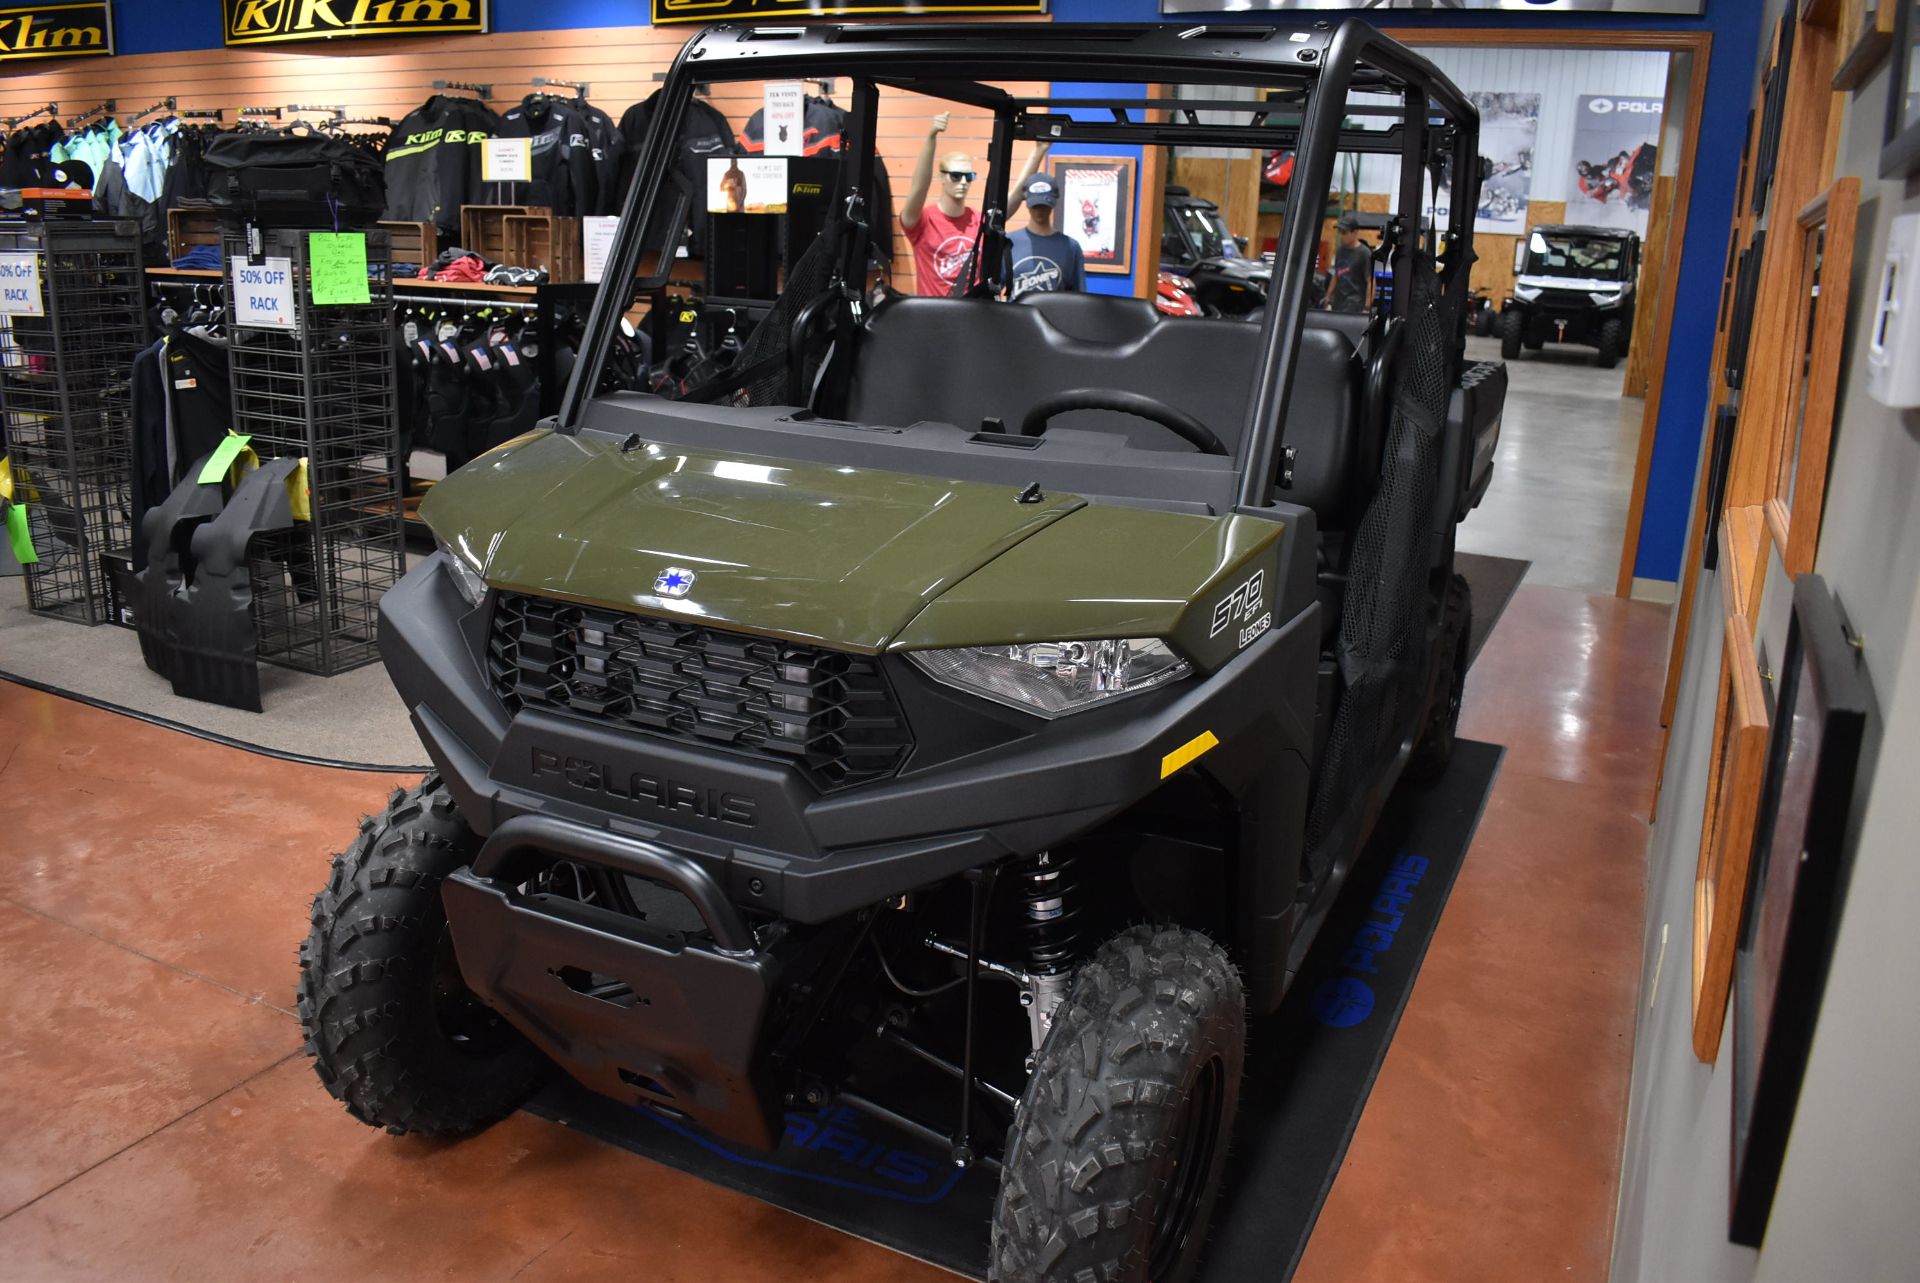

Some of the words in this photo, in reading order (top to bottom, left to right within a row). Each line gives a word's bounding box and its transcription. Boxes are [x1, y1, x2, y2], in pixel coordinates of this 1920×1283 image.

[294, 0, 473, 30] Klim
[0, 265, 13, 278] 0%
[15, 265, 32, 278] OFF
[240, 270, 262, 284] 50%
[264, 271, 285, 285] OFF
[5, 288, 28, 301] RACK
[249, 296, 279, 311] RACK
[1210, 568, 1264, 639] 570
[1244, 598, 1263, 622] EFI
[531, 745, 759, 829] POLARIS
